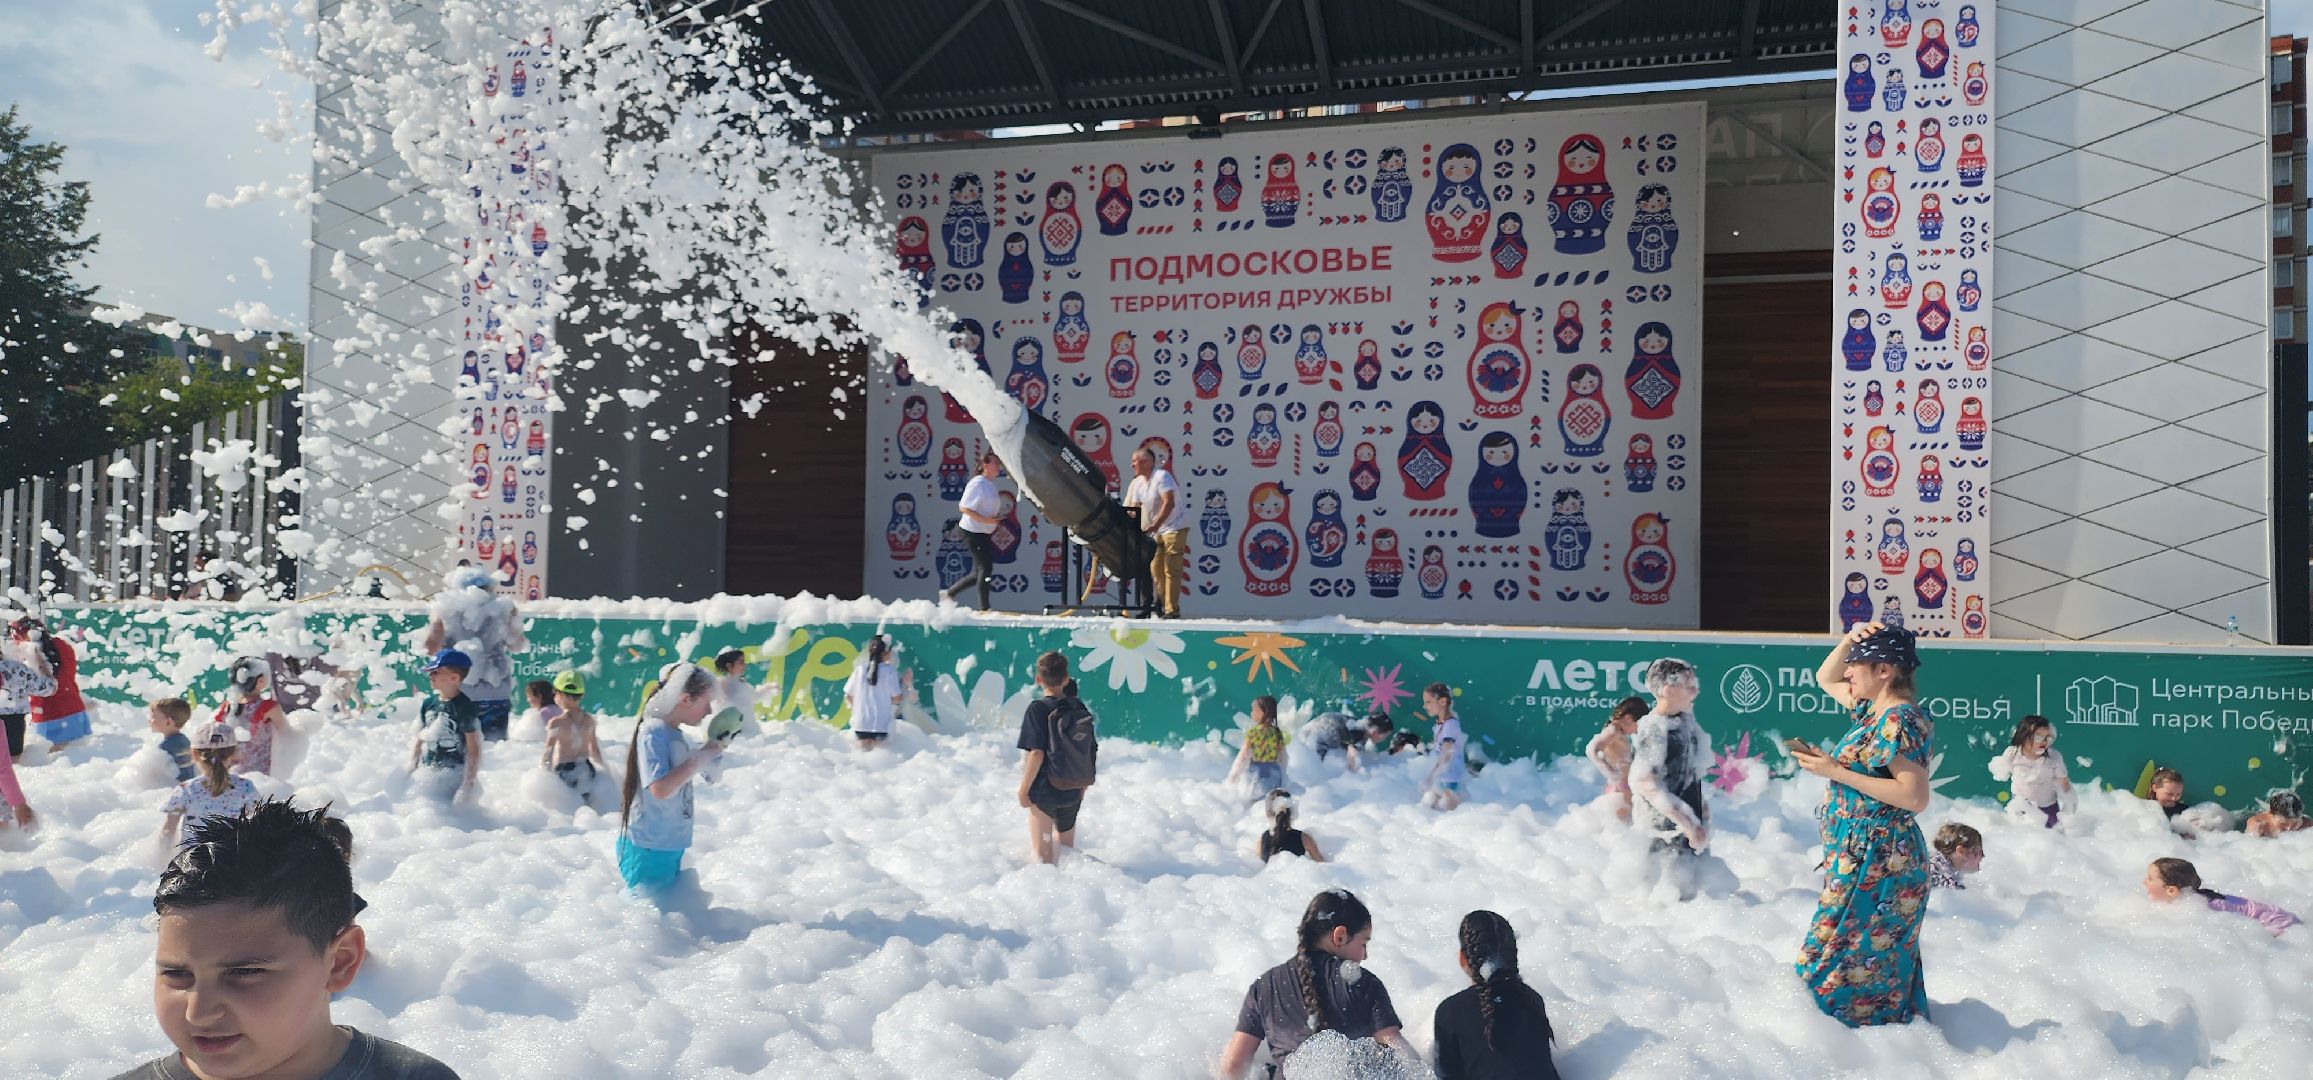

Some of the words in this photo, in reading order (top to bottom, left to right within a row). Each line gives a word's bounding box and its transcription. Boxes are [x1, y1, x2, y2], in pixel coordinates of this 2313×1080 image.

[1110, 246, 1392, 285] ПОДМОСКОВЬЕ
[1110, 291, 1271, 312] ТЕРРИТОРИЯ
[1277, 286, 1392, 310] ДРУЖБЫ
[1526, 697, 1536, 705] в
[1778, 692, 2011, 720] ПОДОВЬЯ
[2152, 712, 2213, 733] парк
[2222, 709, 2313, 735] Побед
